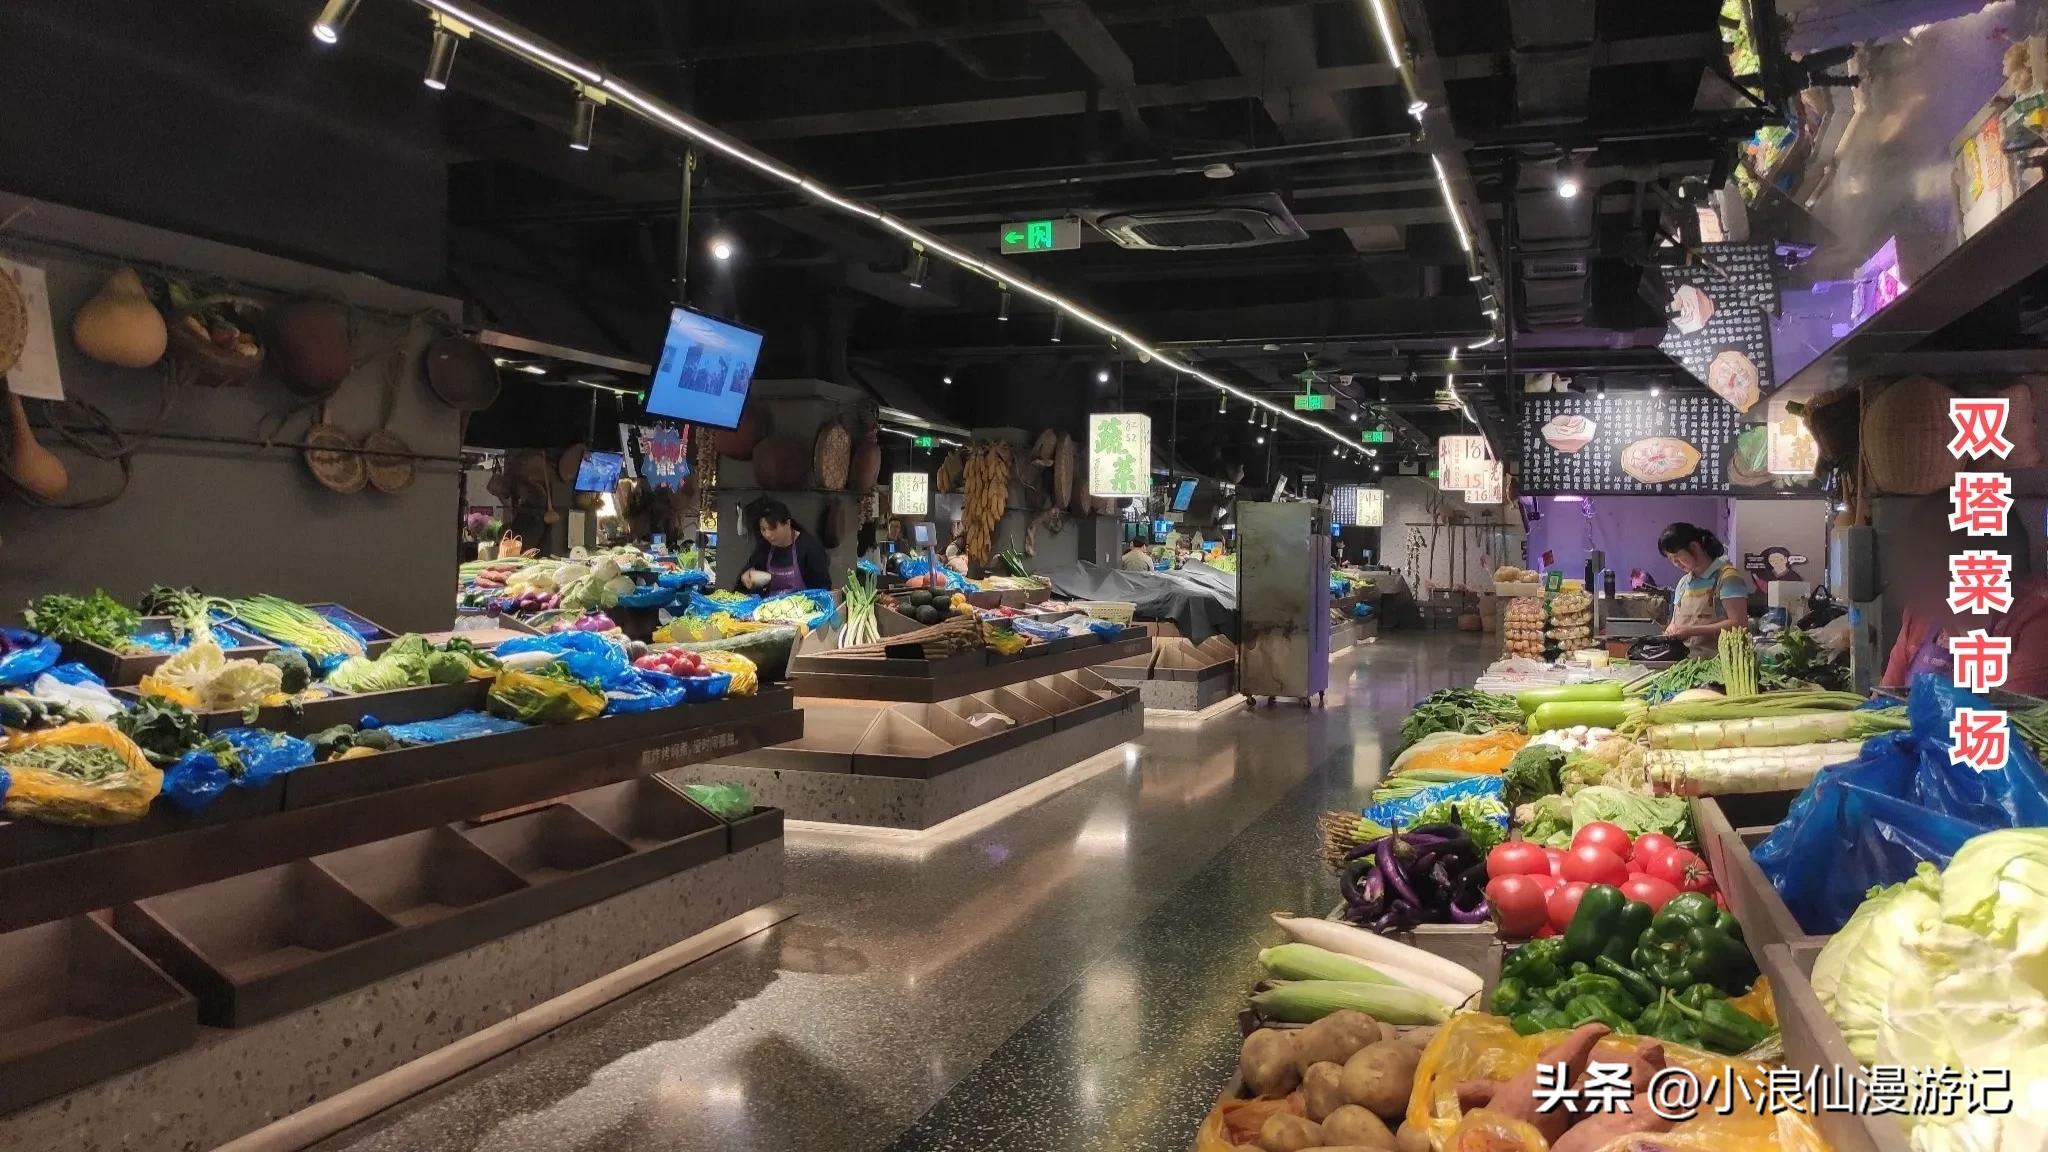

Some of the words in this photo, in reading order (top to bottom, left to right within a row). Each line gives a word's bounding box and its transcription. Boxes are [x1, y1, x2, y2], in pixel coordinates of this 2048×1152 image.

[1095, 416, 1137, 494] 蔬菜
[1464, 473, 1482, 488] 15
[912, 502, 926, 513] 50
